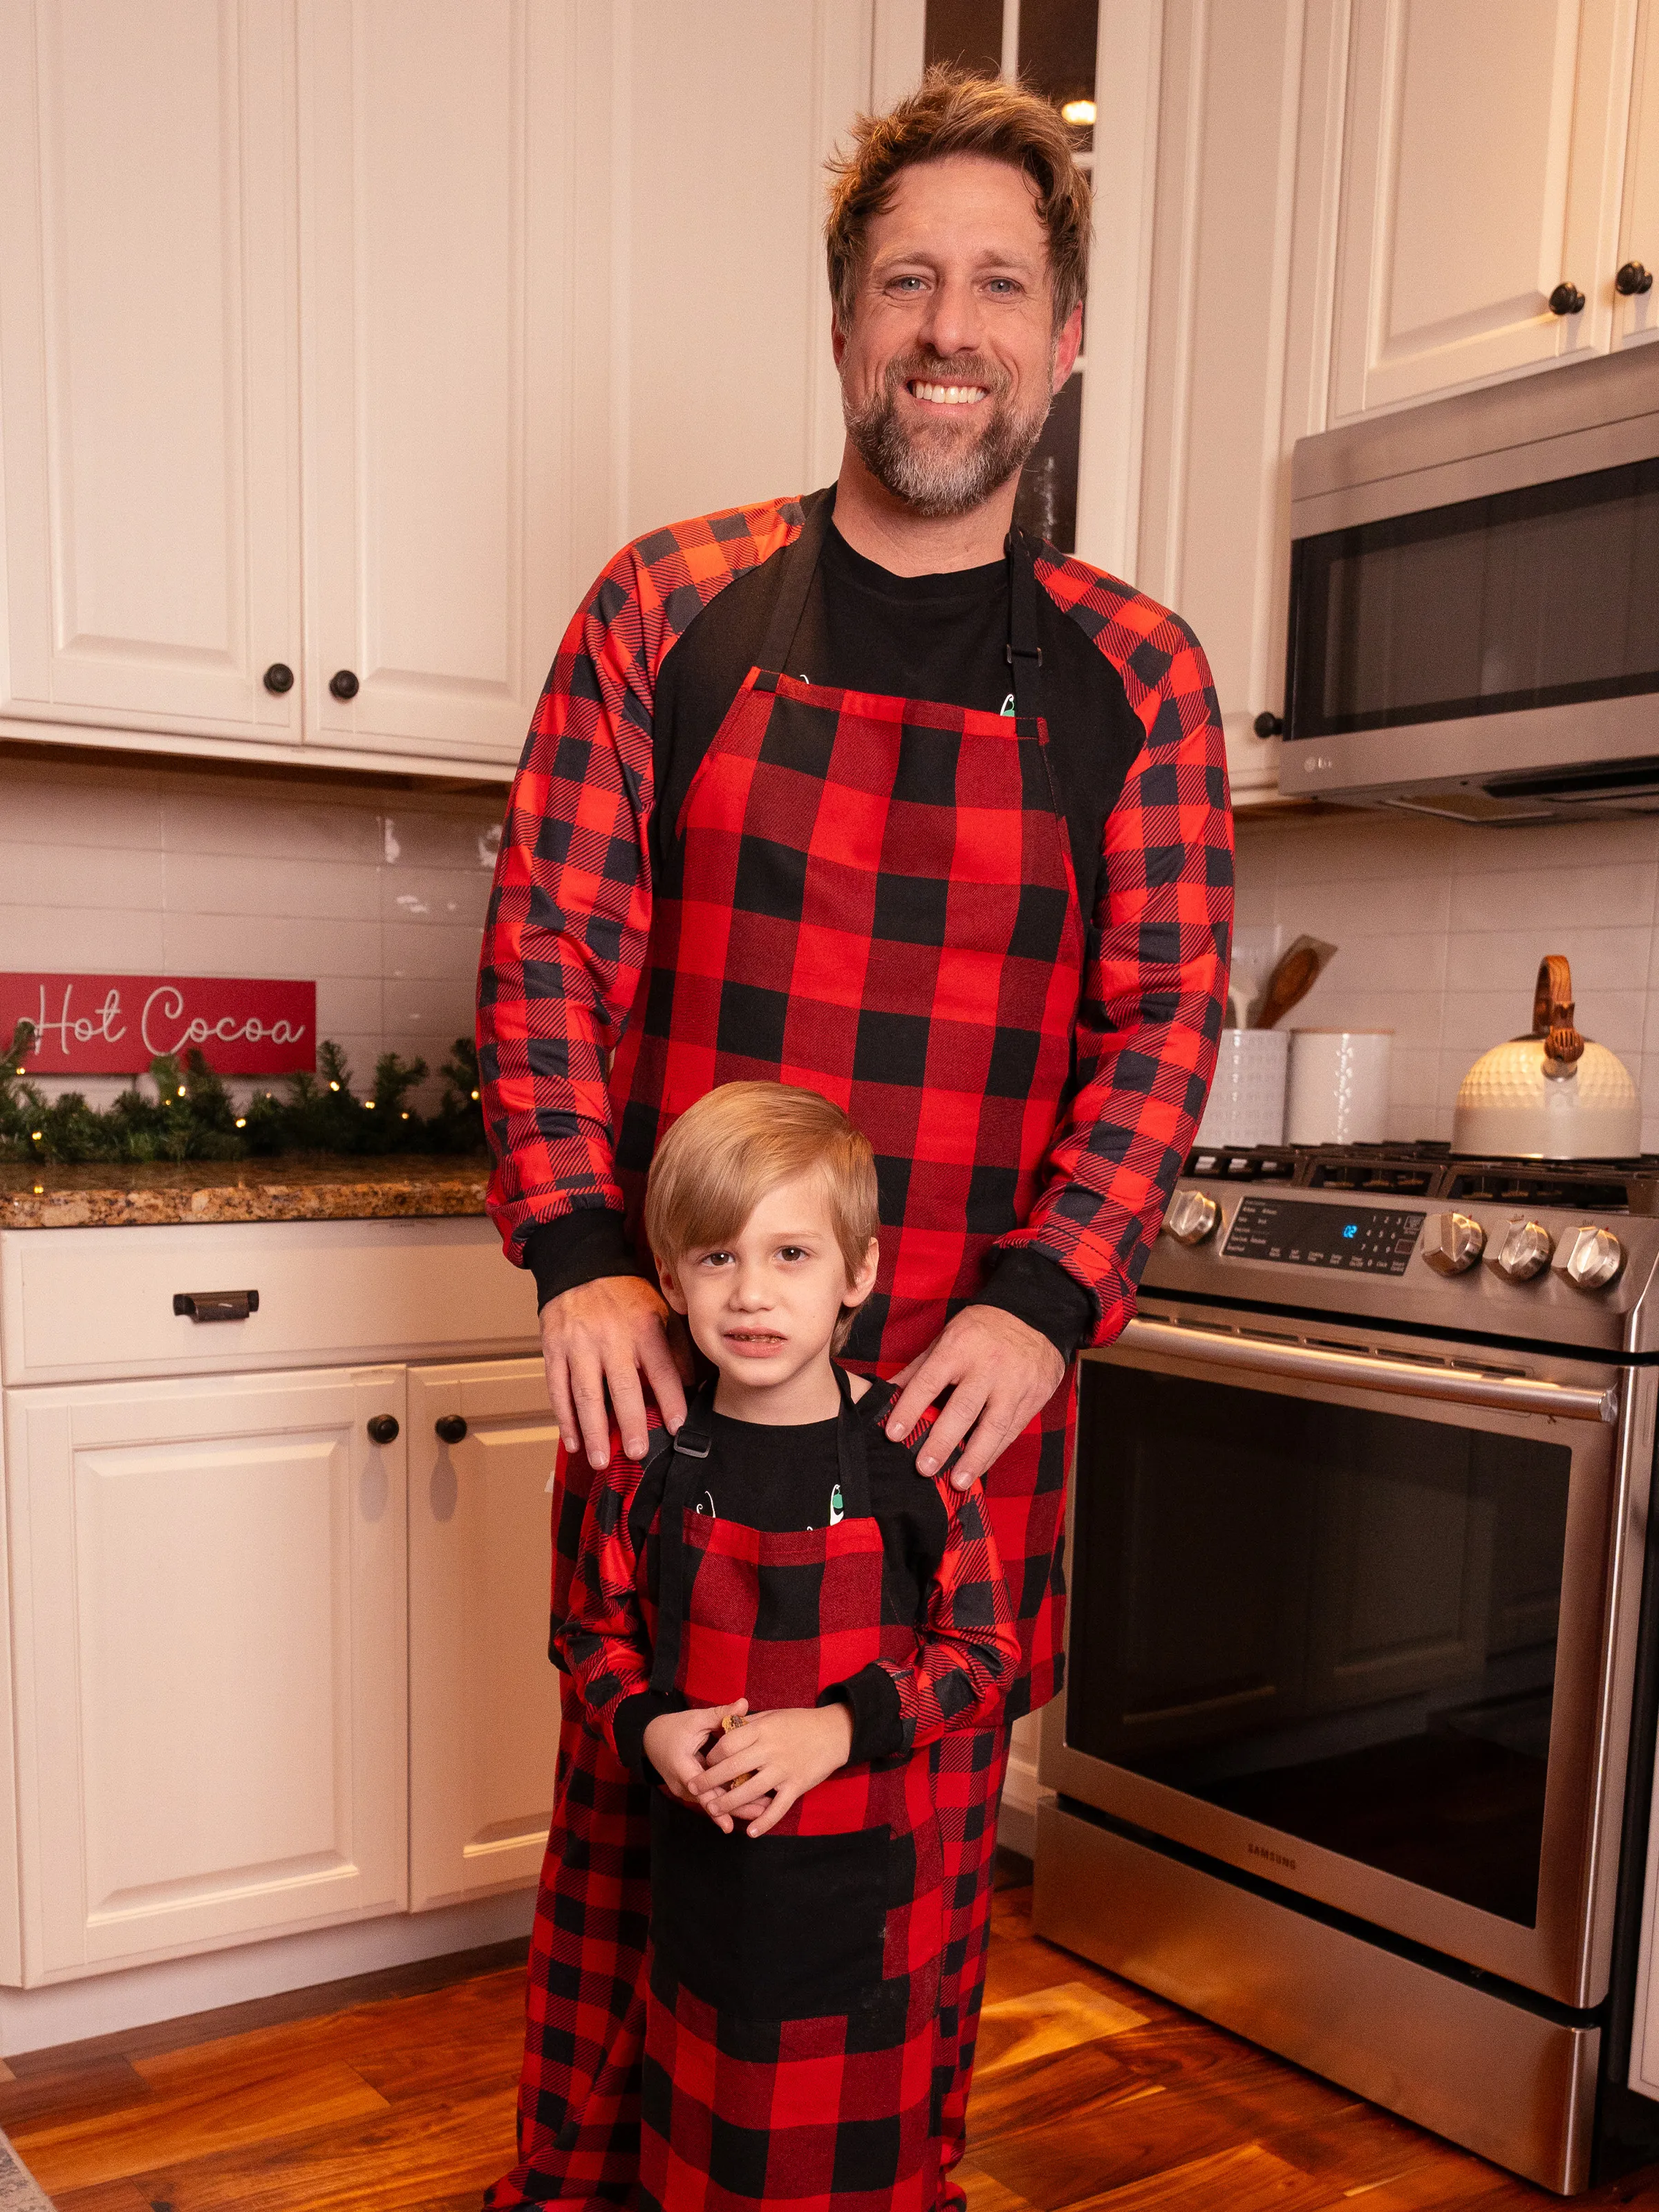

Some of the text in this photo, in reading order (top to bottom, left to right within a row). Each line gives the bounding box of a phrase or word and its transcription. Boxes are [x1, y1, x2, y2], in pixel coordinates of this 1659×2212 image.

[17, 984, 306, 1057] Hot Cocoa
[1248, 1844, 1296, 1870] SAMSUNG
